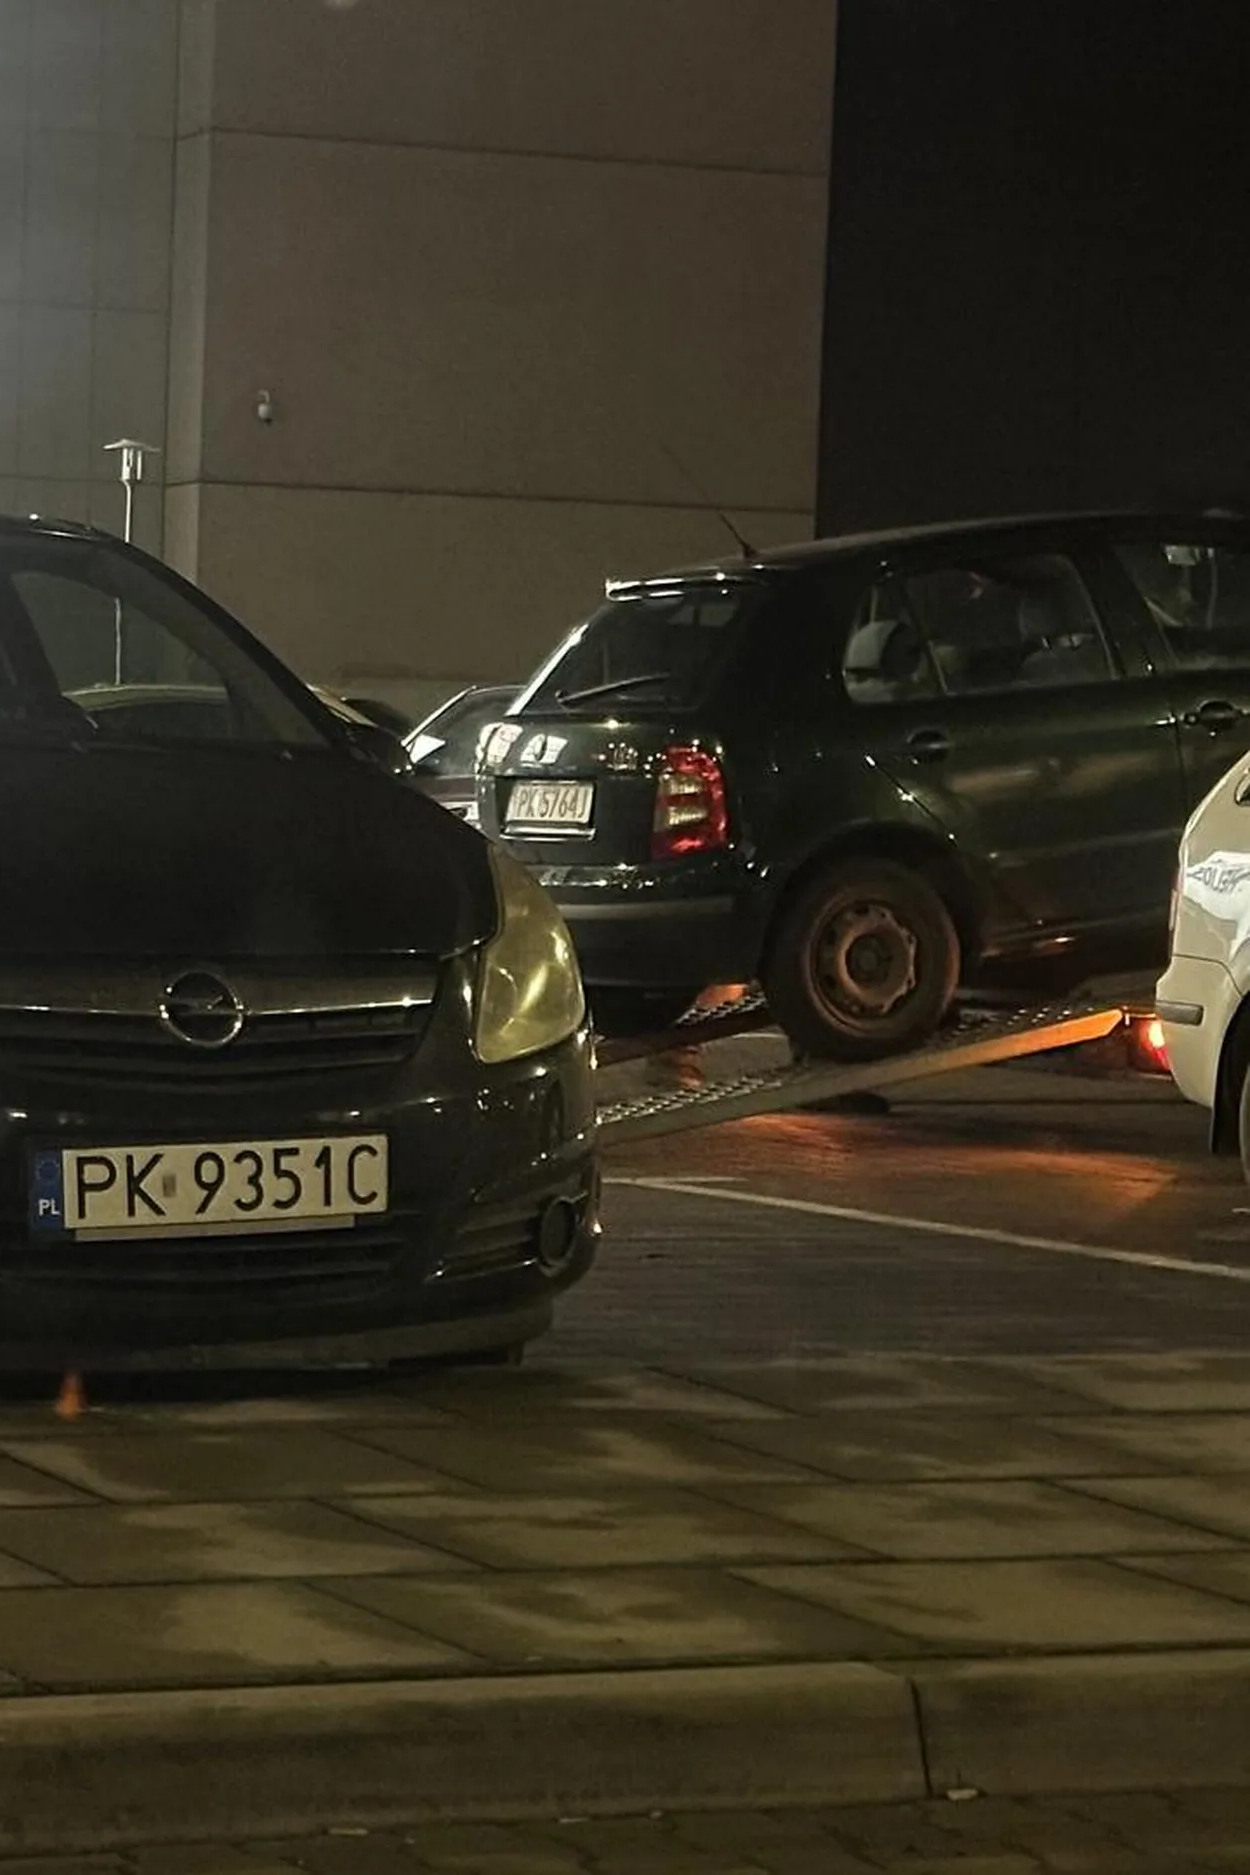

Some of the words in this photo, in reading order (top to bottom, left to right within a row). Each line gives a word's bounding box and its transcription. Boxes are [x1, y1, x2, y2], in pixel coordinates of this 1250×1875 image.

[75, 1153, 166, 1220] PK
[193, 1143, 379, 1216] 9351C
[38, 1198, 61, 1217] PL
